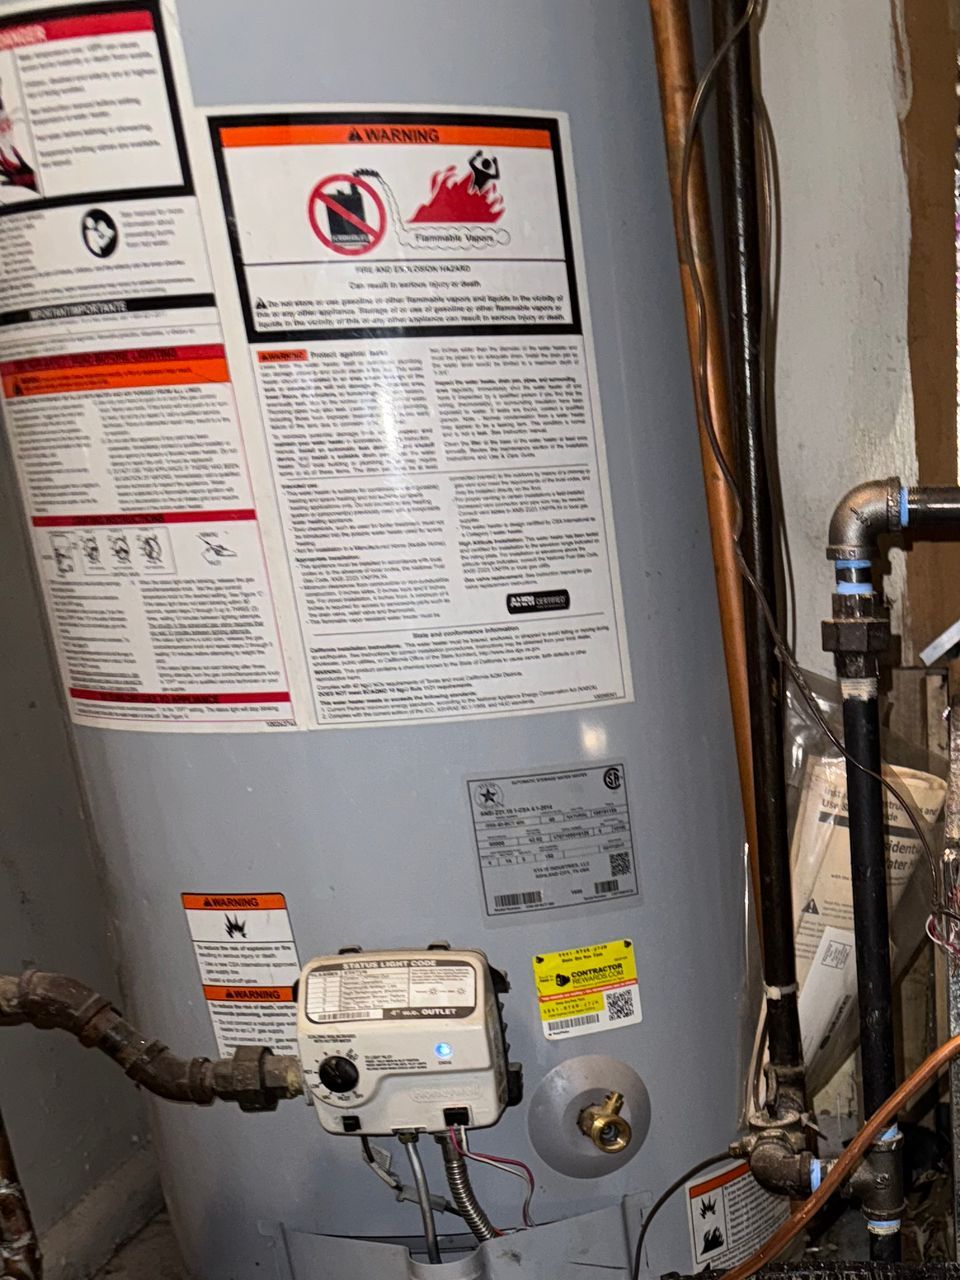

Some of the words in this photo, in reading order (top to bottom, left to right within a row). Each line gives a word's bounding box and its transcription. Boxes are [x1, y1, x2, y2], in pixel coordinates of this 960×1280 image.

[364, 128, 440, 143] WARNING
[416, 233, 462, 243] Flammable
[212, 897, 259, 907] WARNING
[342, 960, 378, 970] STATUS
[380, 960, 409, 968] LIGHT
[411, 959, 437, 967] CODE
[571, 962, 623, 978] CONTRACTOR
[572, 970, 624, 985] REWARDS.COM
[233, 989, 281, 1000] WARNING
[421, 1008, 457, 1016] OUTLET
